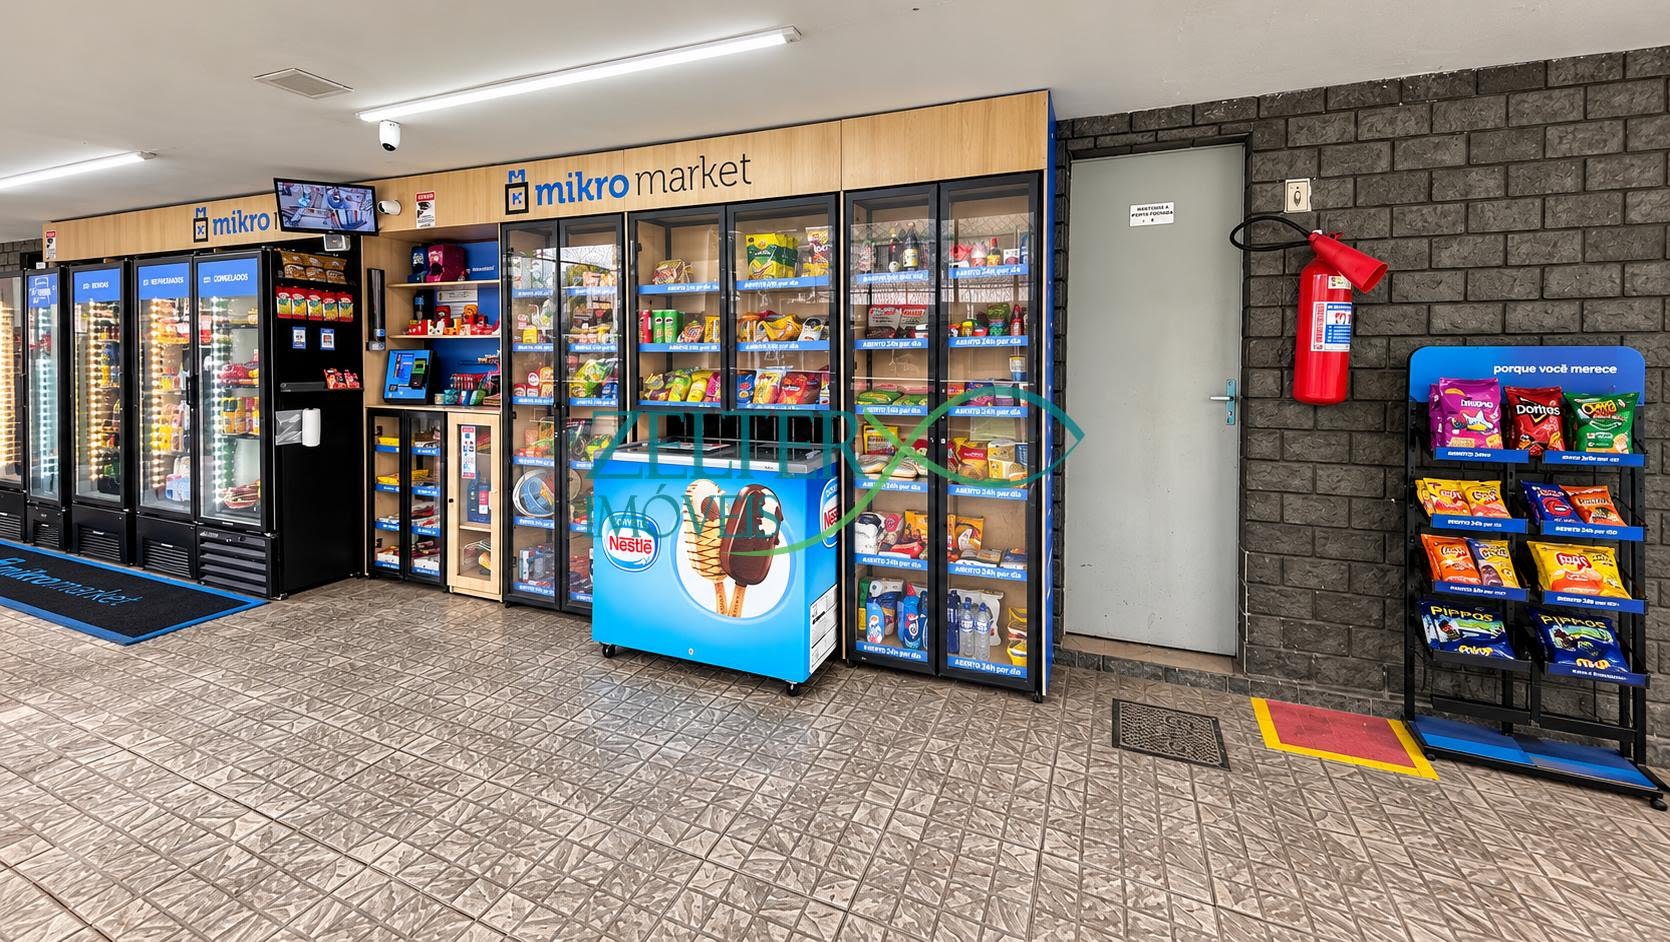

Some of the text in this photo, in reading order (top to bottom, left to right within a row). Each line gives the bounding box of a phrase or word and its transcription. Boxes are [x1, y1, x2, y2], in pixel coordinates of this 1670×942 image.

[535, 153, 752, 206] mikro market
[212, 209, 270, 235] mikro
[1493, 364, 1617, 375] porque você merece
[1516, 403, 1560, 416] Doritos
